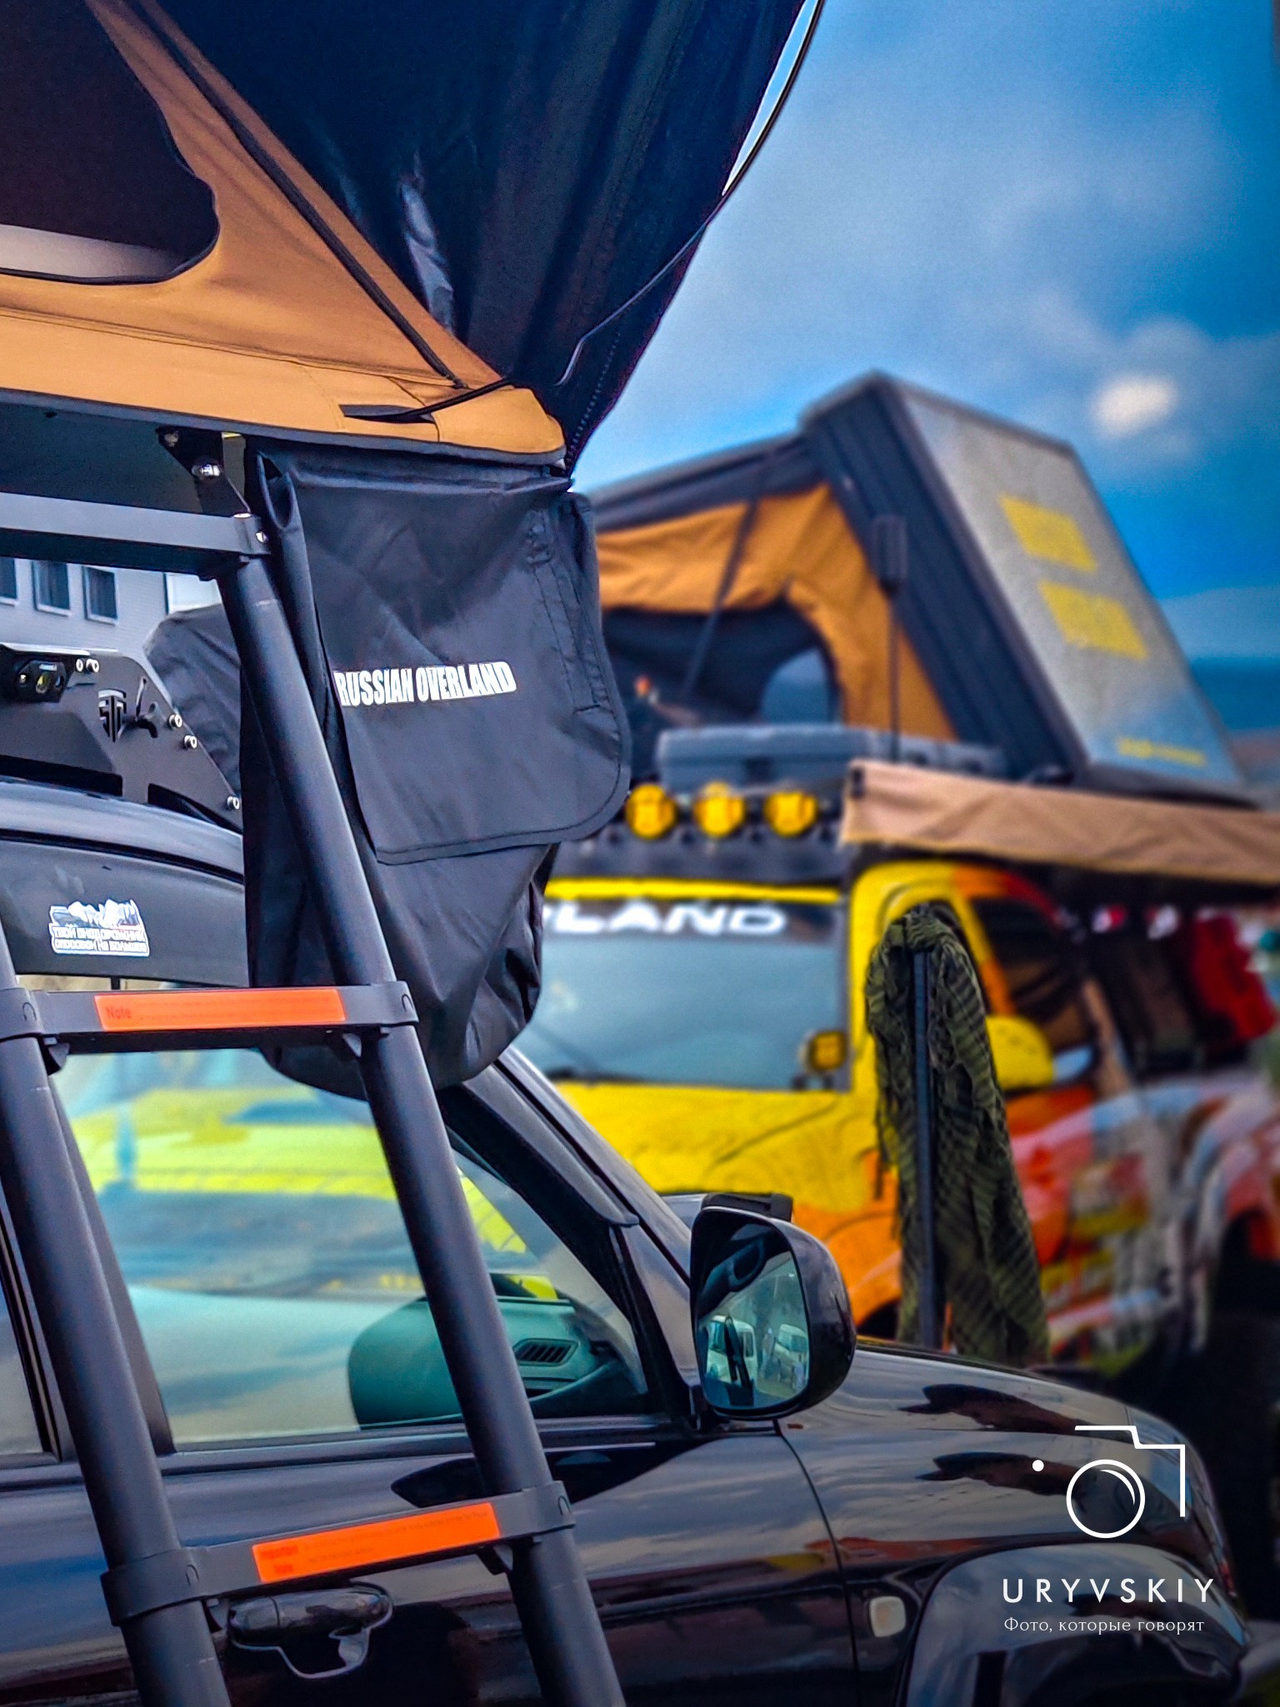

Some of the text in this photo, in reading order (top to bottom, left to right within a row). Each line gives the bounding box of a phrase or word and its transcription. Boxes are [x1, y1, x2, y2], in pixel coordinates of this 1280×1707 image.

[333, 661, 517, 706] RUSSIAN OVERLAND
[543, 900, 787, 935] LAND
